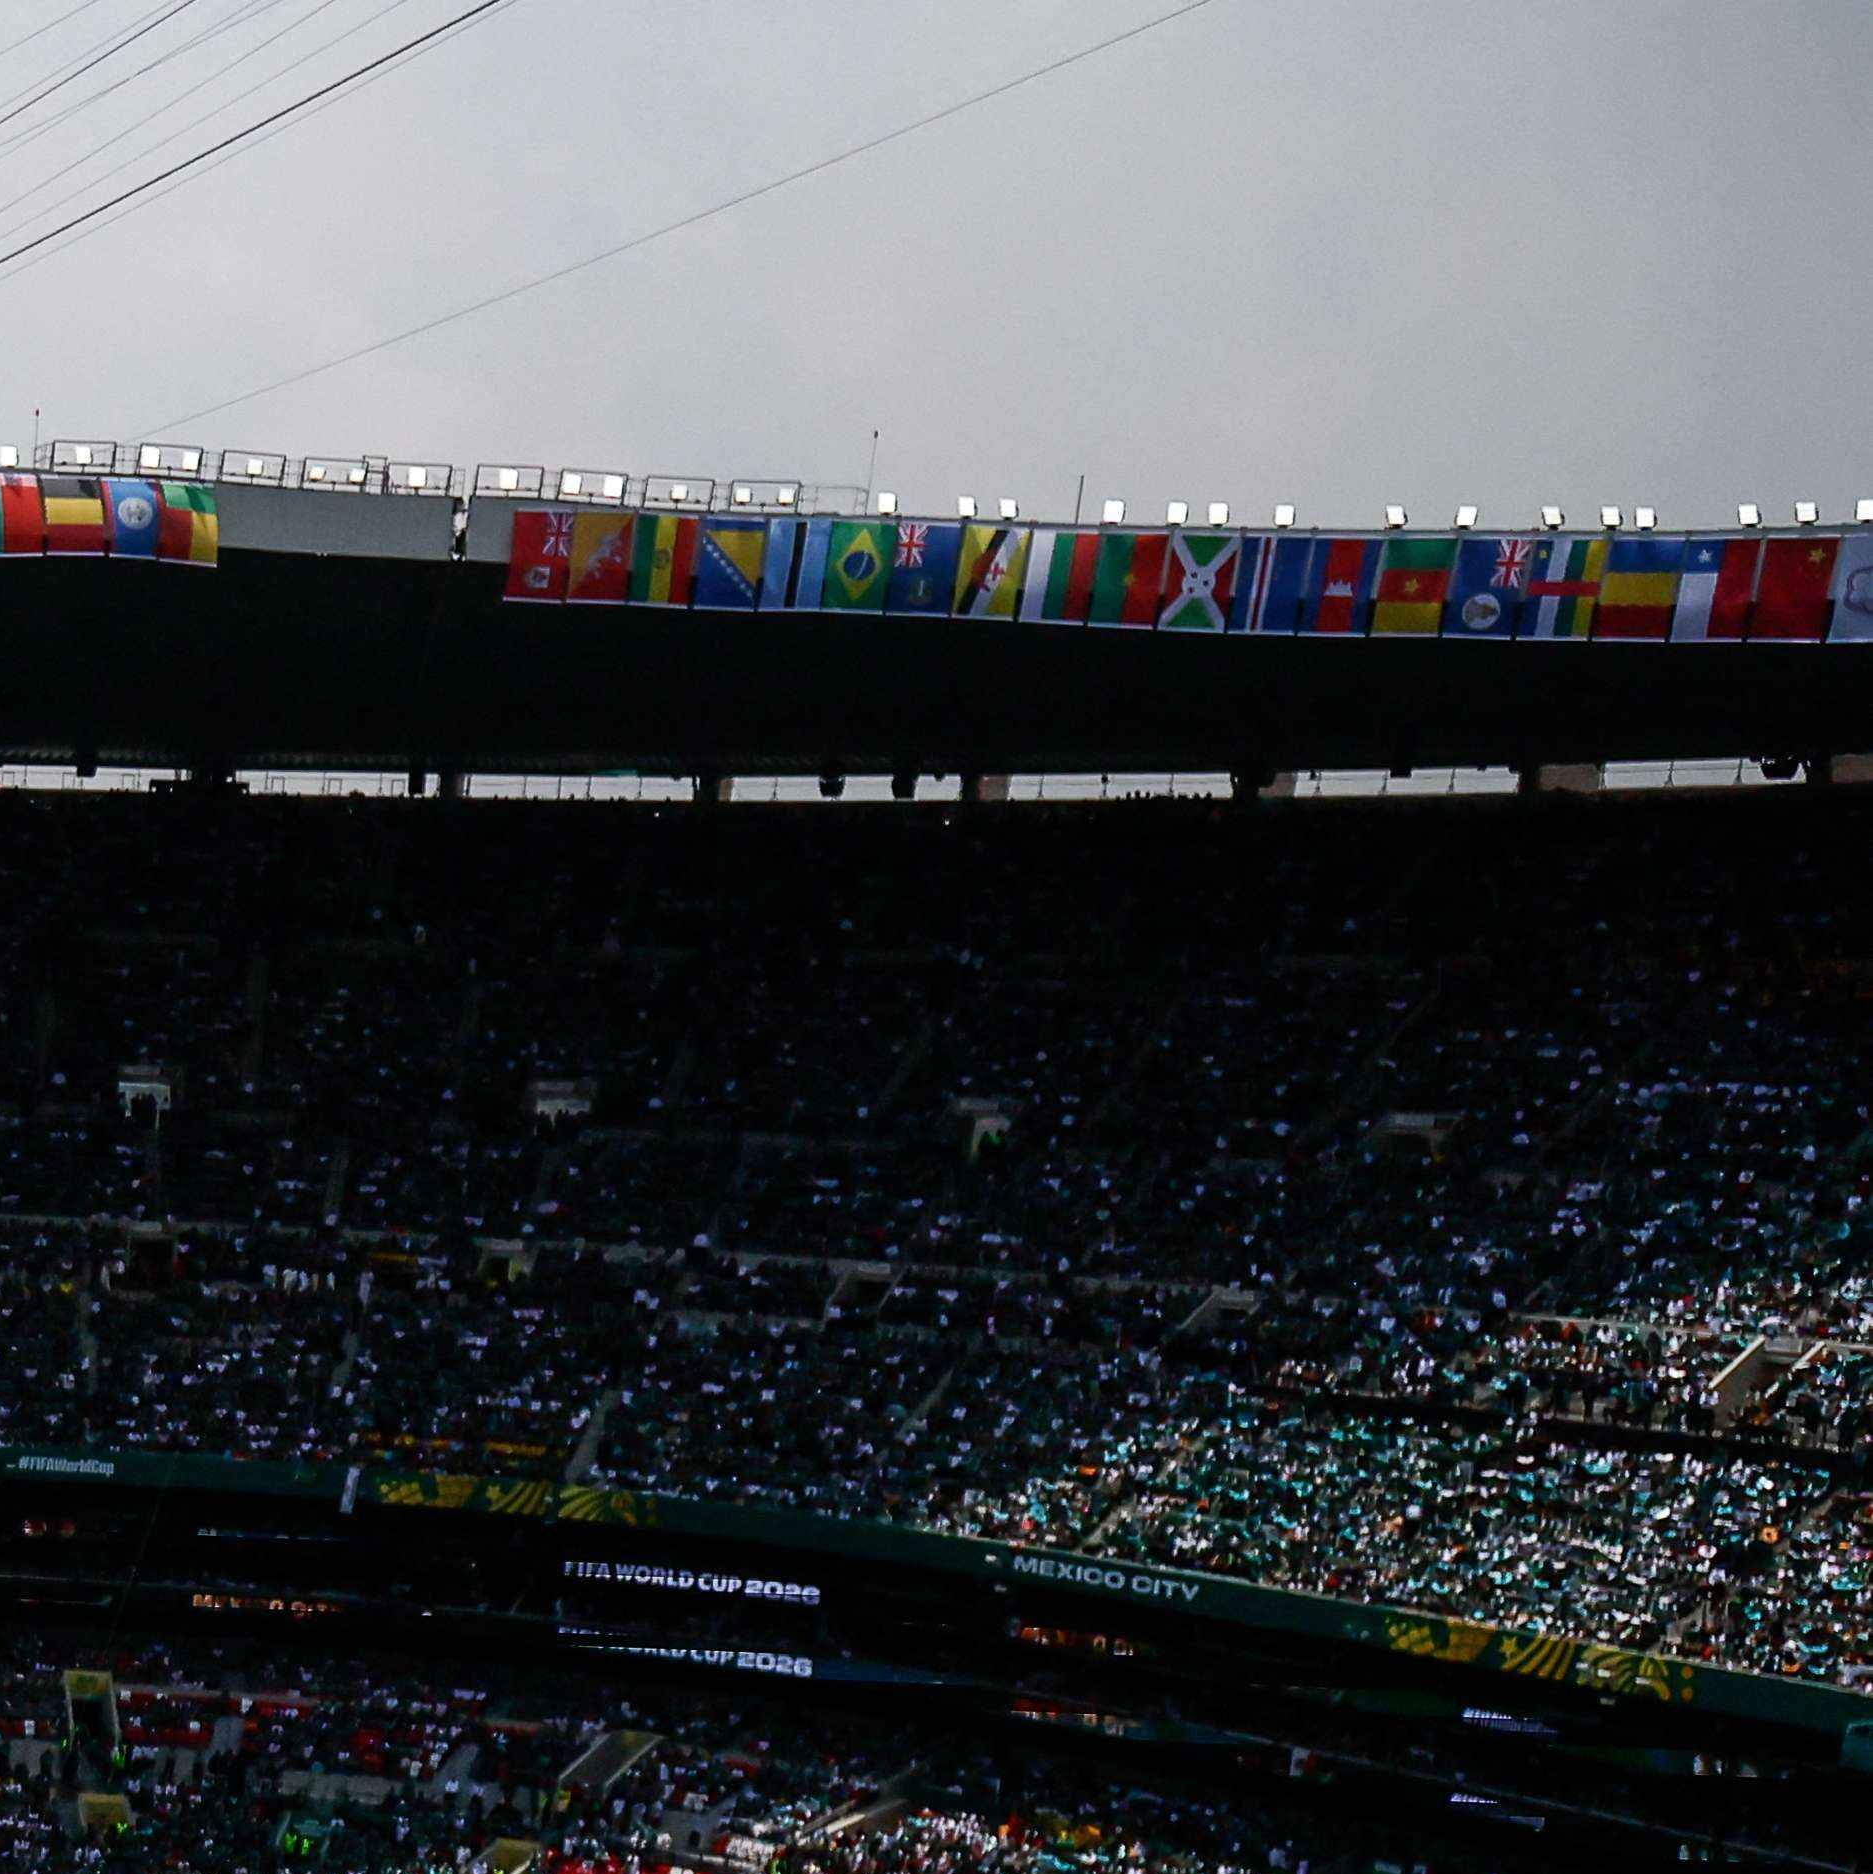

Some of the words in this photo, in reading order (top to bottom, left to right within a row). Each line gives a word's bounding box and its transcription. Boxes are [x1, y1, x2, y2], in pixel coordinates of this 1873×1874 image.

[563, 1561, 611, 1581] FIFA
[615, 1564, 695, 1591] WORLD
[697, 1572, 742, 1593] CUP
[1013, 1555, 1126, 1589] MEXICO
[1132, 1576, 1200, 1601] CITY
[736, 1651, 813, 1679] 2026
